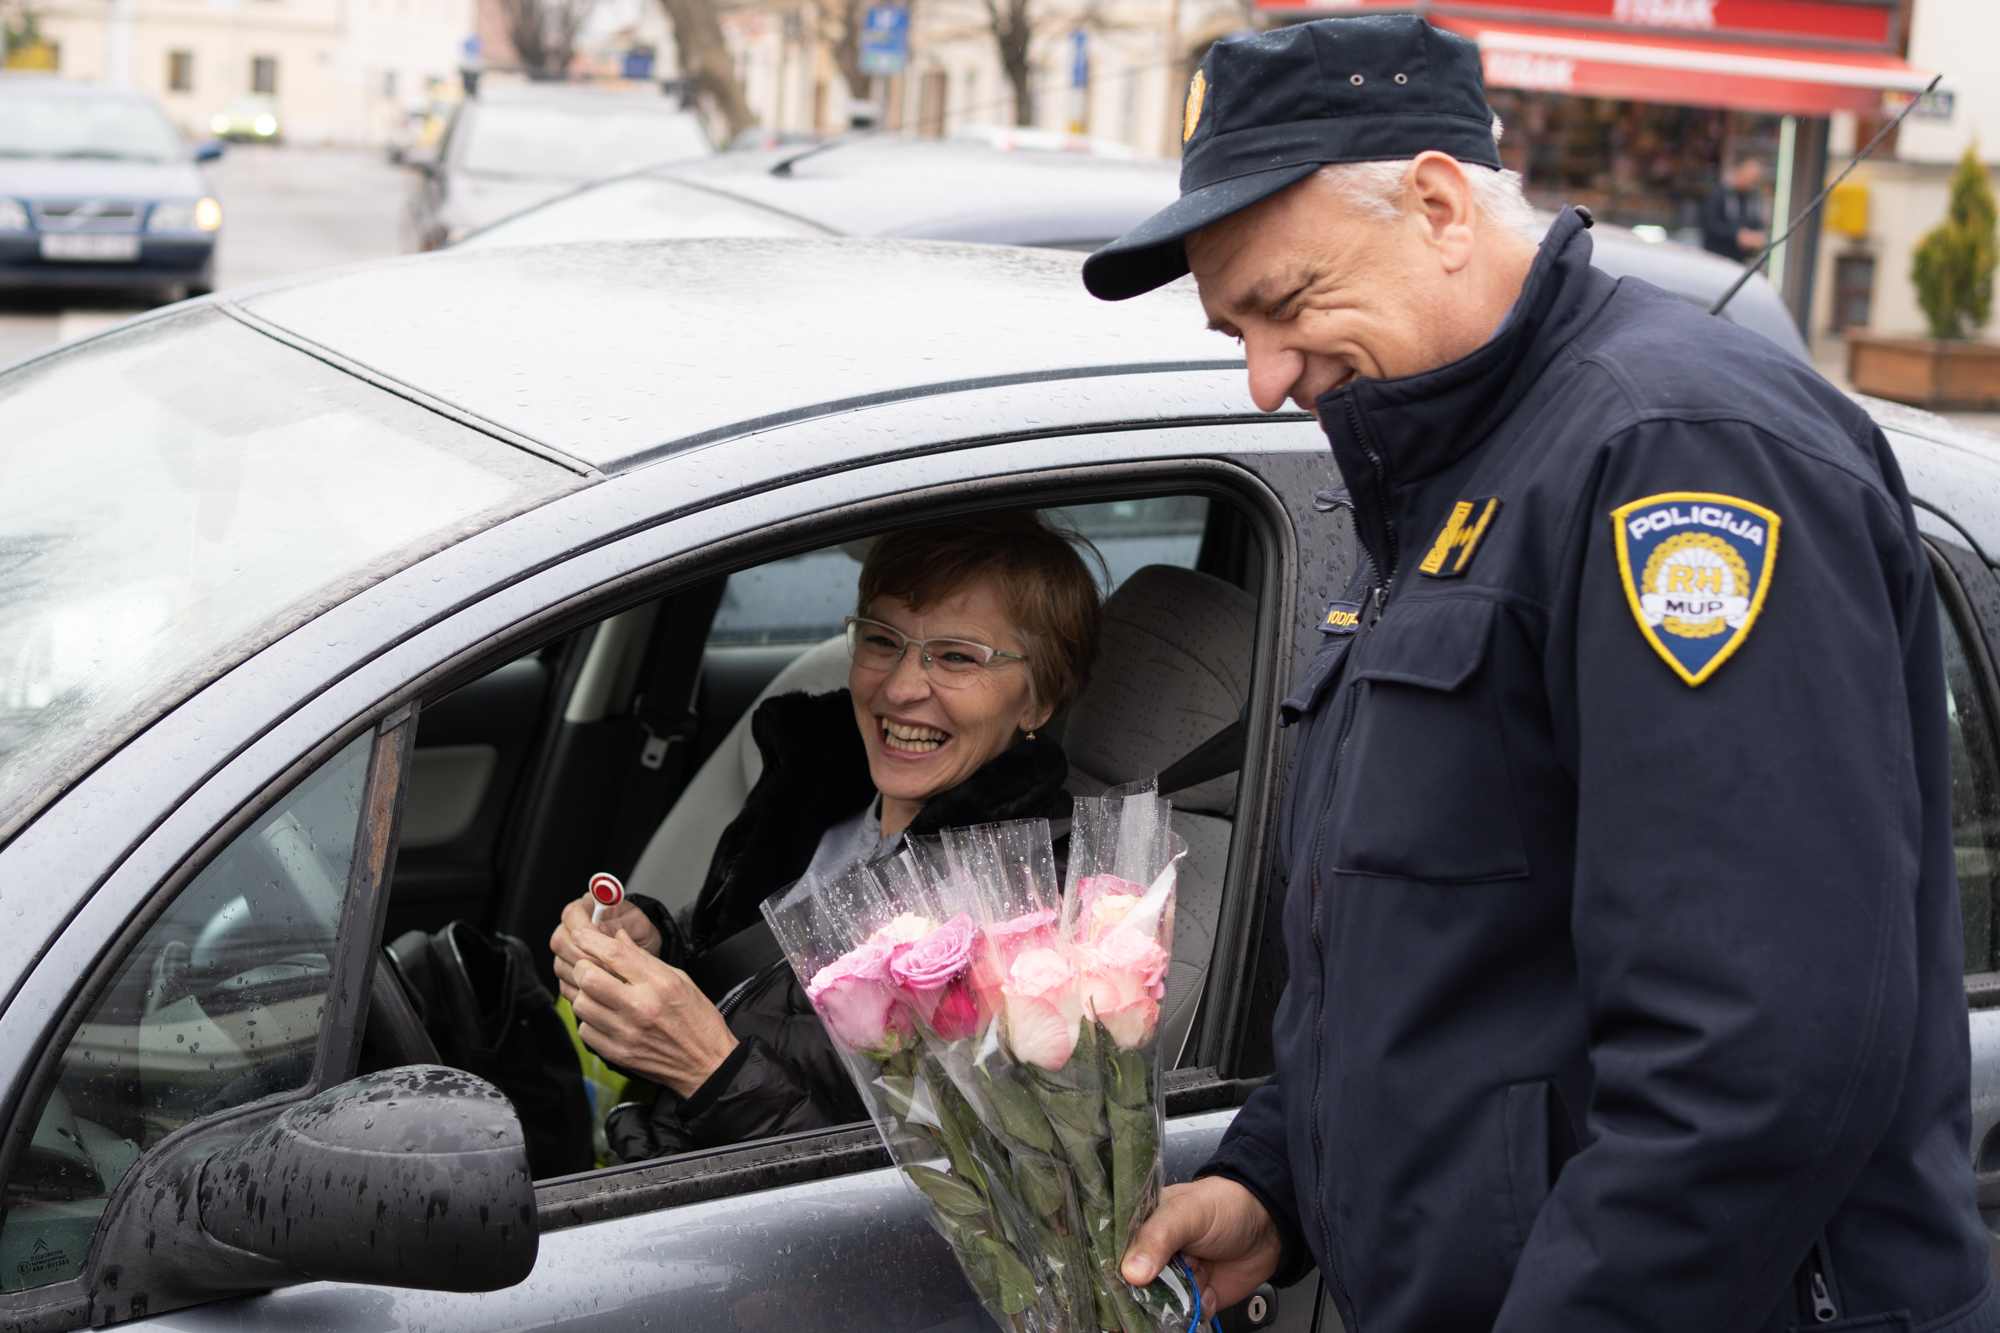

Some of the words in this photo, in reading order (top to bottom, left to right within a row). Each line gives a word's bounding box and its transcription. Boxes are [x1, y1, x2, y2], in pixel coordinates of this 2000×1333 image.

[1628, 506, 1764, 546] POLICIJA
[1668, 565, 1722, 594] RH
[1666, 600, 1723, 615] MUP
